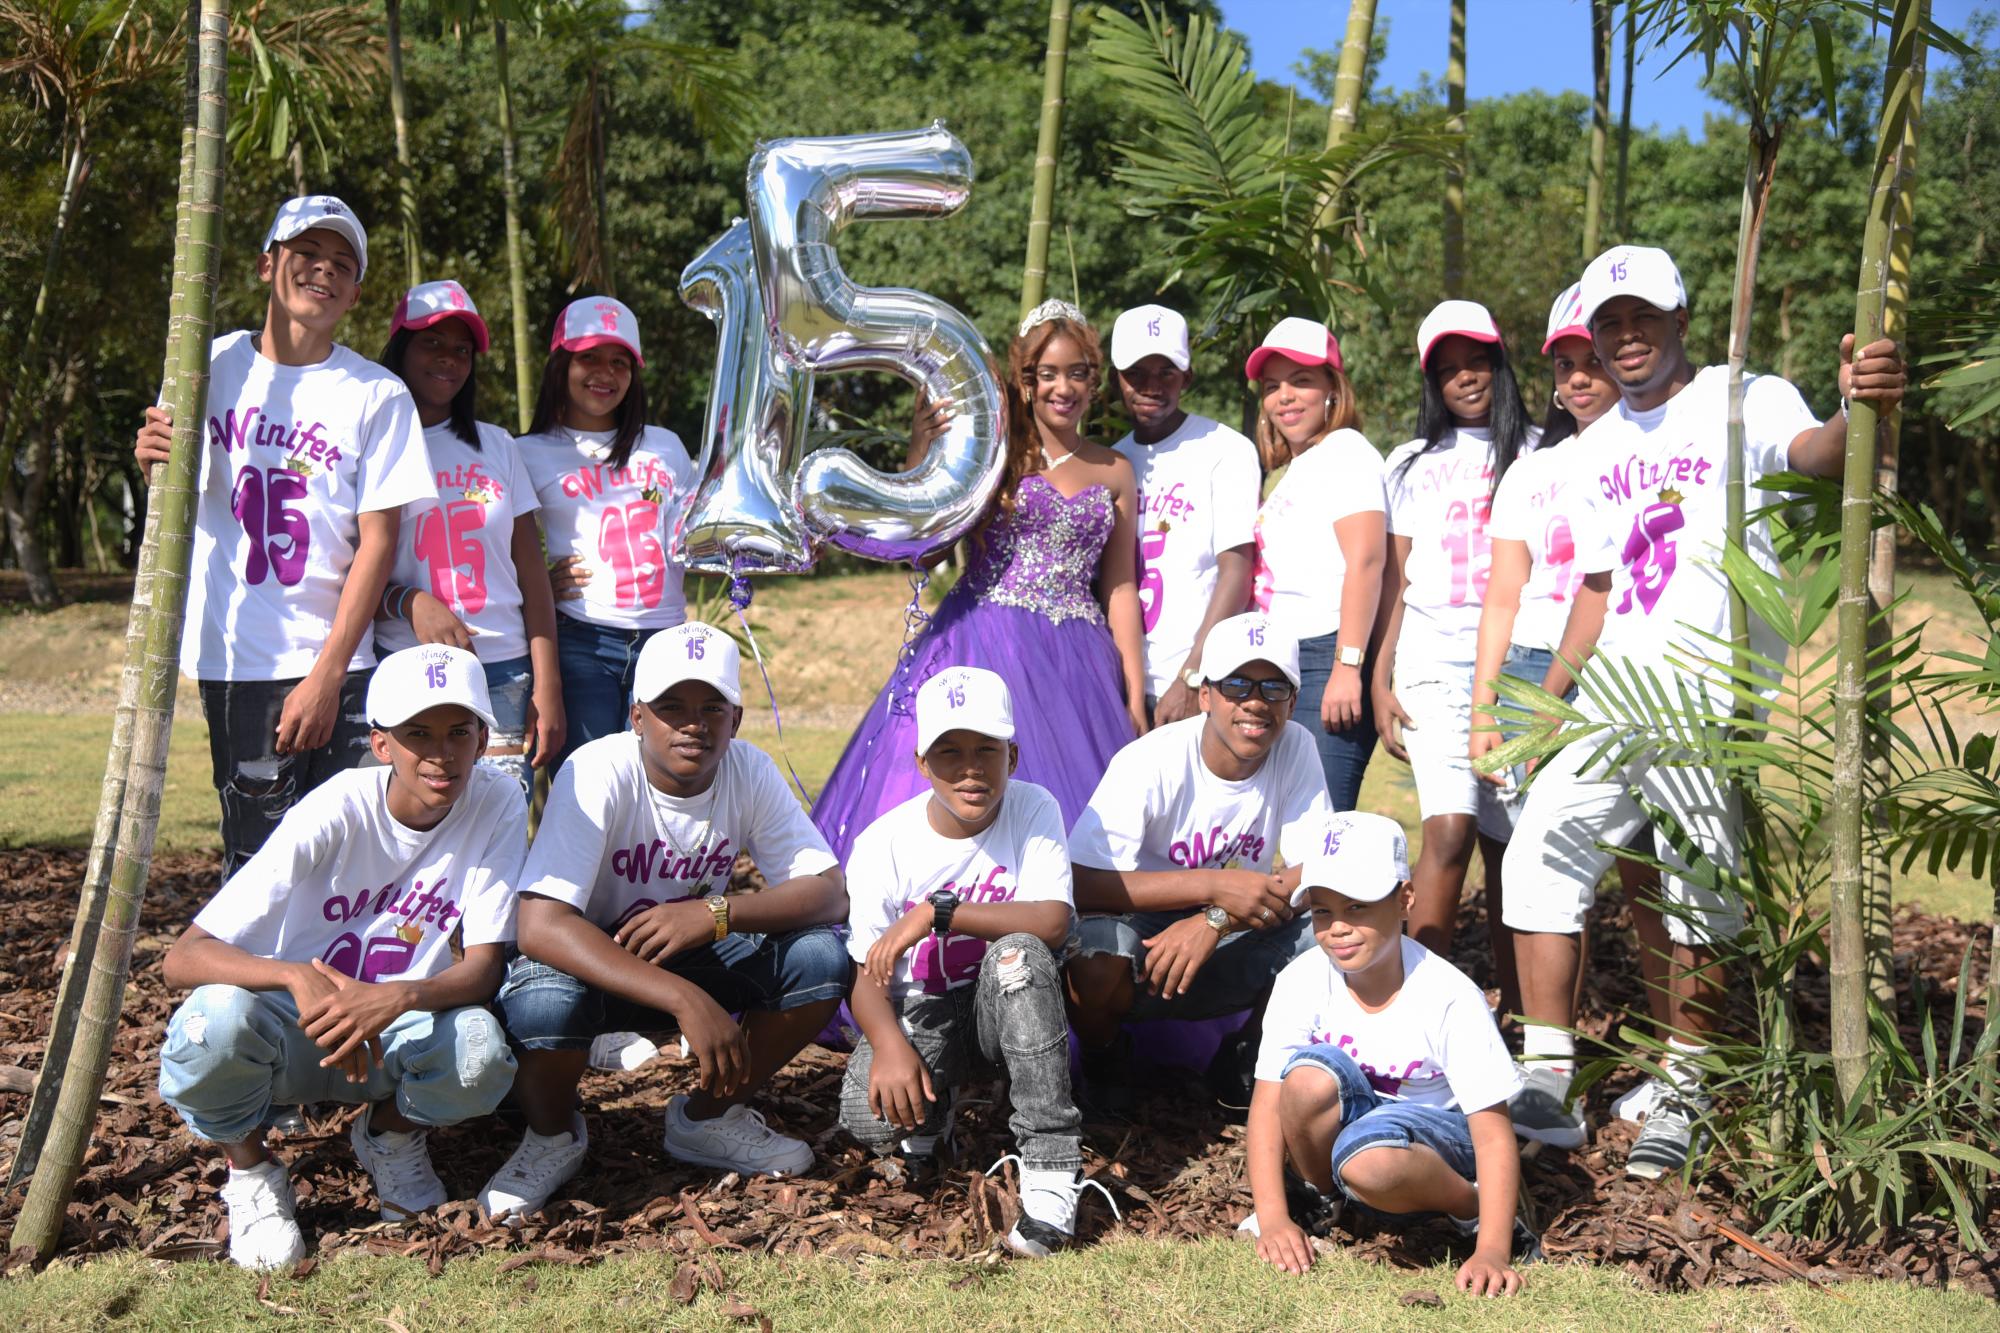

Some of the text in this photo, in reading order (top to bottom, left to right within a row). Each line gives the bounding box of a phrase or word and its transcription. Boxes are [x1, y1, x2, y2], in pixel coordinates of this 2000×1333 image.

[1610, 261, 1627, 282] 15
[1147, 319, 1161, 337] 15
[678, 124, 1009, 572] 15
[210, 406, 342, 472] Winifer
[436, 463, 504, 500] nifer
[231, 465, 310, 586] 15
[414, 500, 488, 615] 15
[598, 500, 666, 609] 15
[1616, 502, 1685, 617] 15
[686, 636, 705, 660] 15
[1247, 627, 1264, 646] 15
[425, 663, 447, 689] 15
[947, 686, 966, 709] 15
